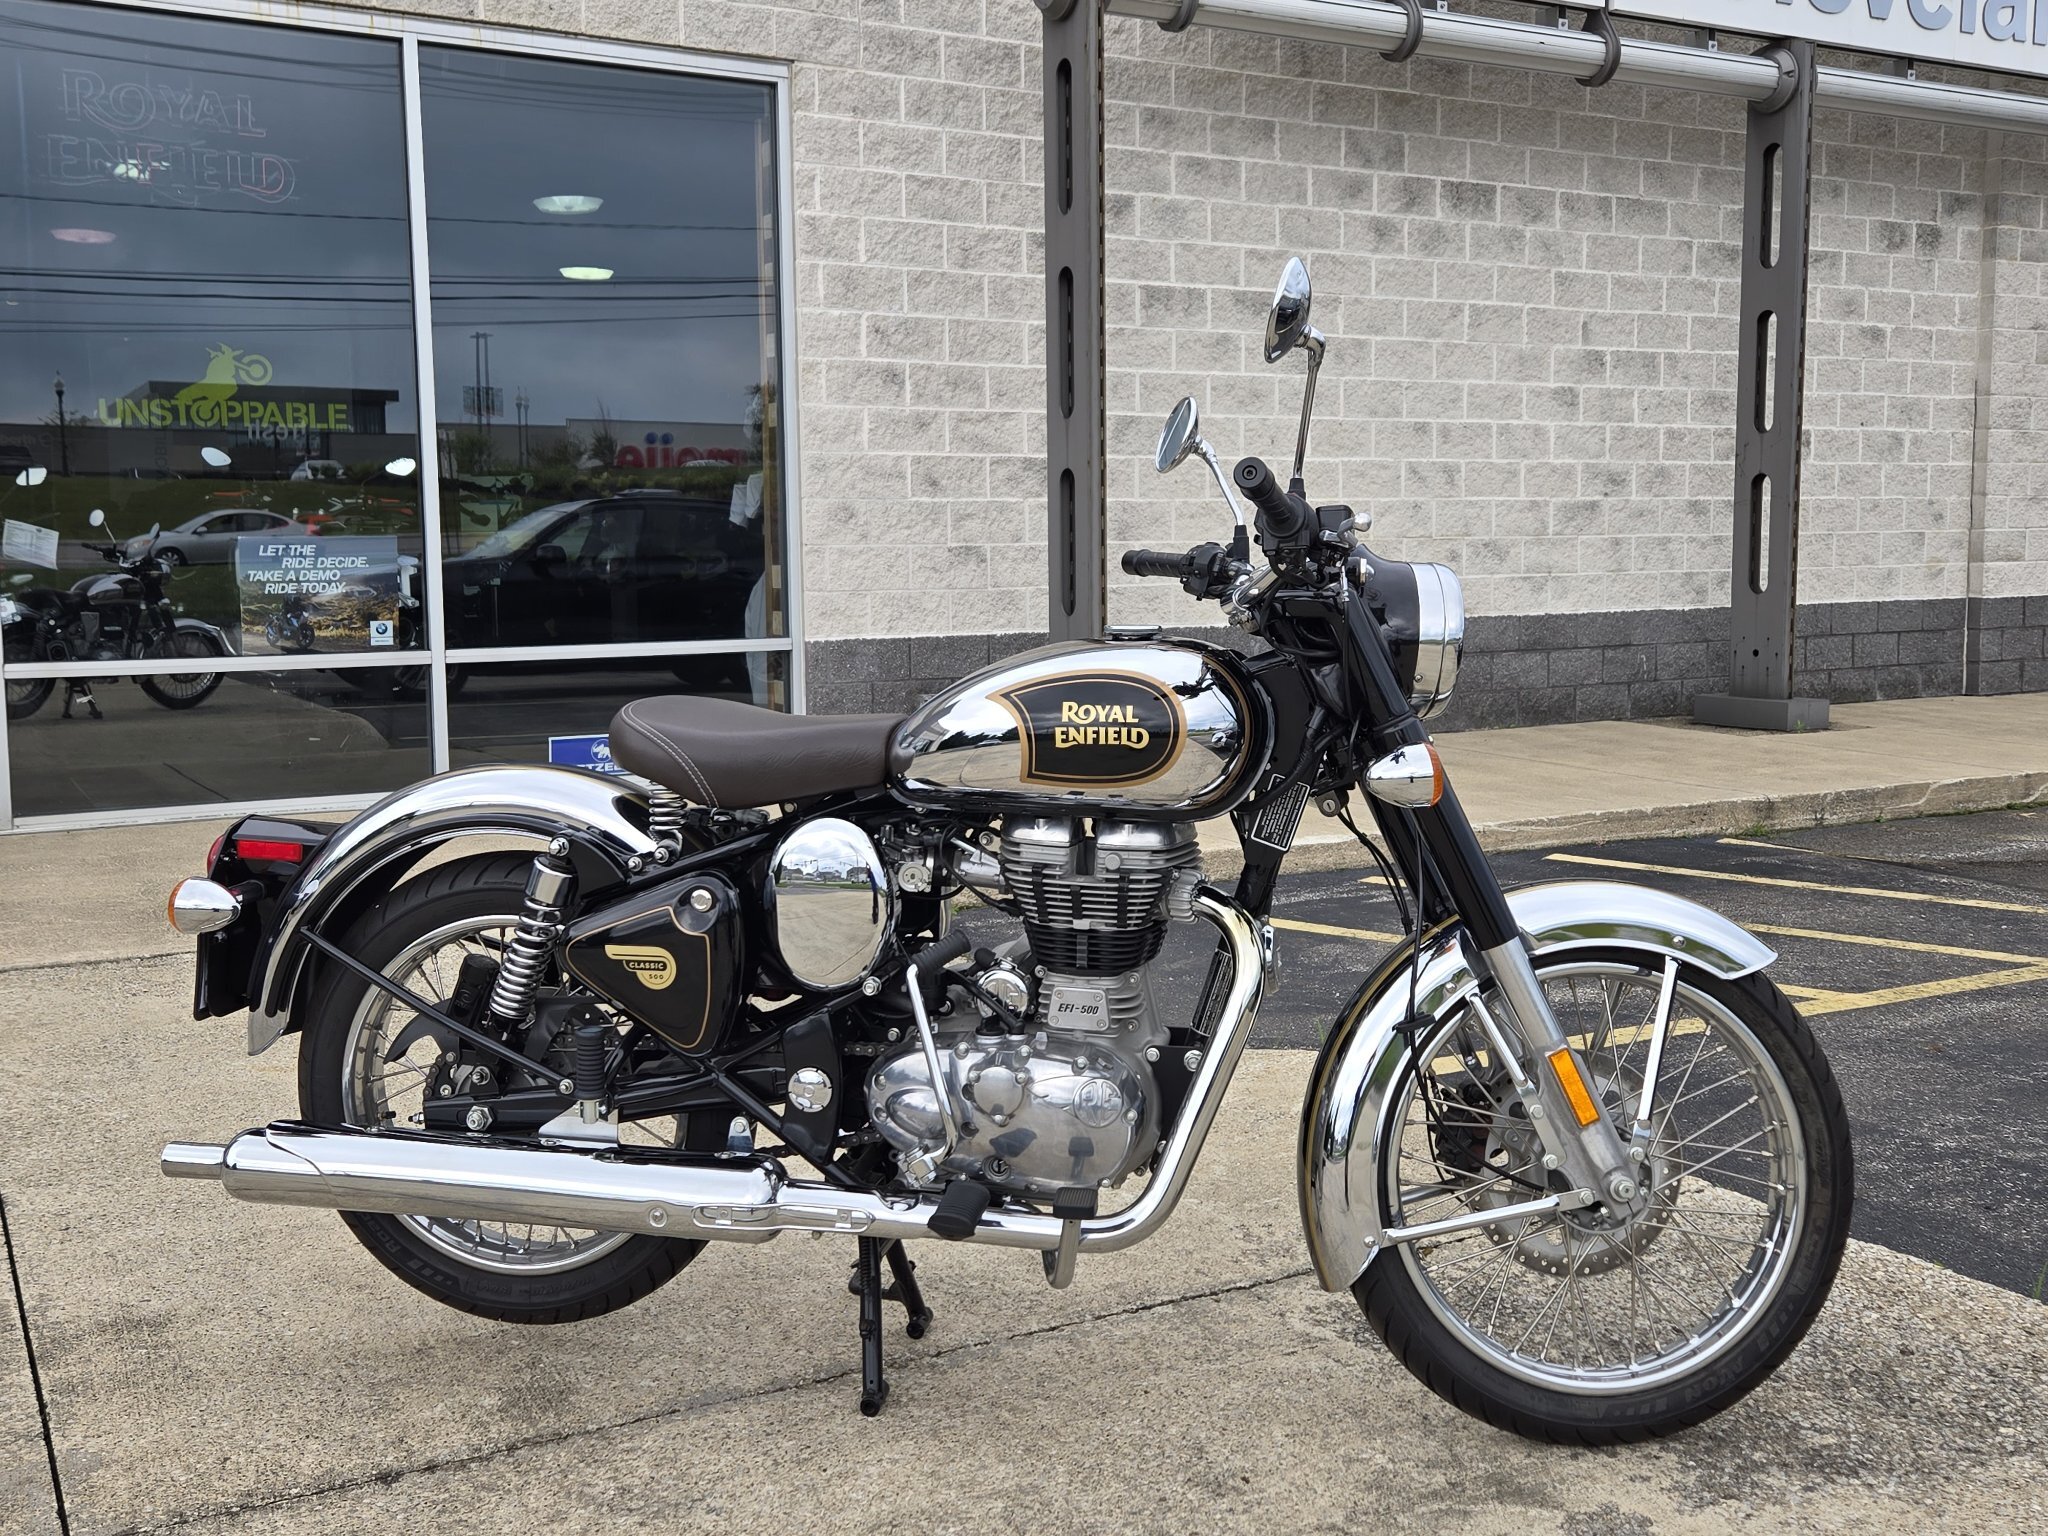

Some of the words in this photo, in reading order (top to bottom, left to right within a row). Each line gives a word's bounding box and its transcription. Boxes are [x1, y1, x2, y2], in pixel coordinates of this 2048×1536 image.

[98, 397, 351, 430] UNSTOPPABLE
[258, 544, 286, 556] LET
[288, 544, 316, 556] THE
[281, 557, 315, 568] RIDE
[317, 556, 369, 568] DECIDE.
[247, 570, 283, 582] TAKE
[285, 570, 296, 581] A
[299, 569, 341, 581] DEMO
[264, 583, 298, 594] RIDE
[301, 581, 347, 594] TODAY.
[1061, 701, 1139, 725] ROYAL
[1054, 726, 1150, 749] ENFIELD
[628, 961, 665, 970] CLASSIC
[1057, 1003, 1100, 1015] EFI-500
